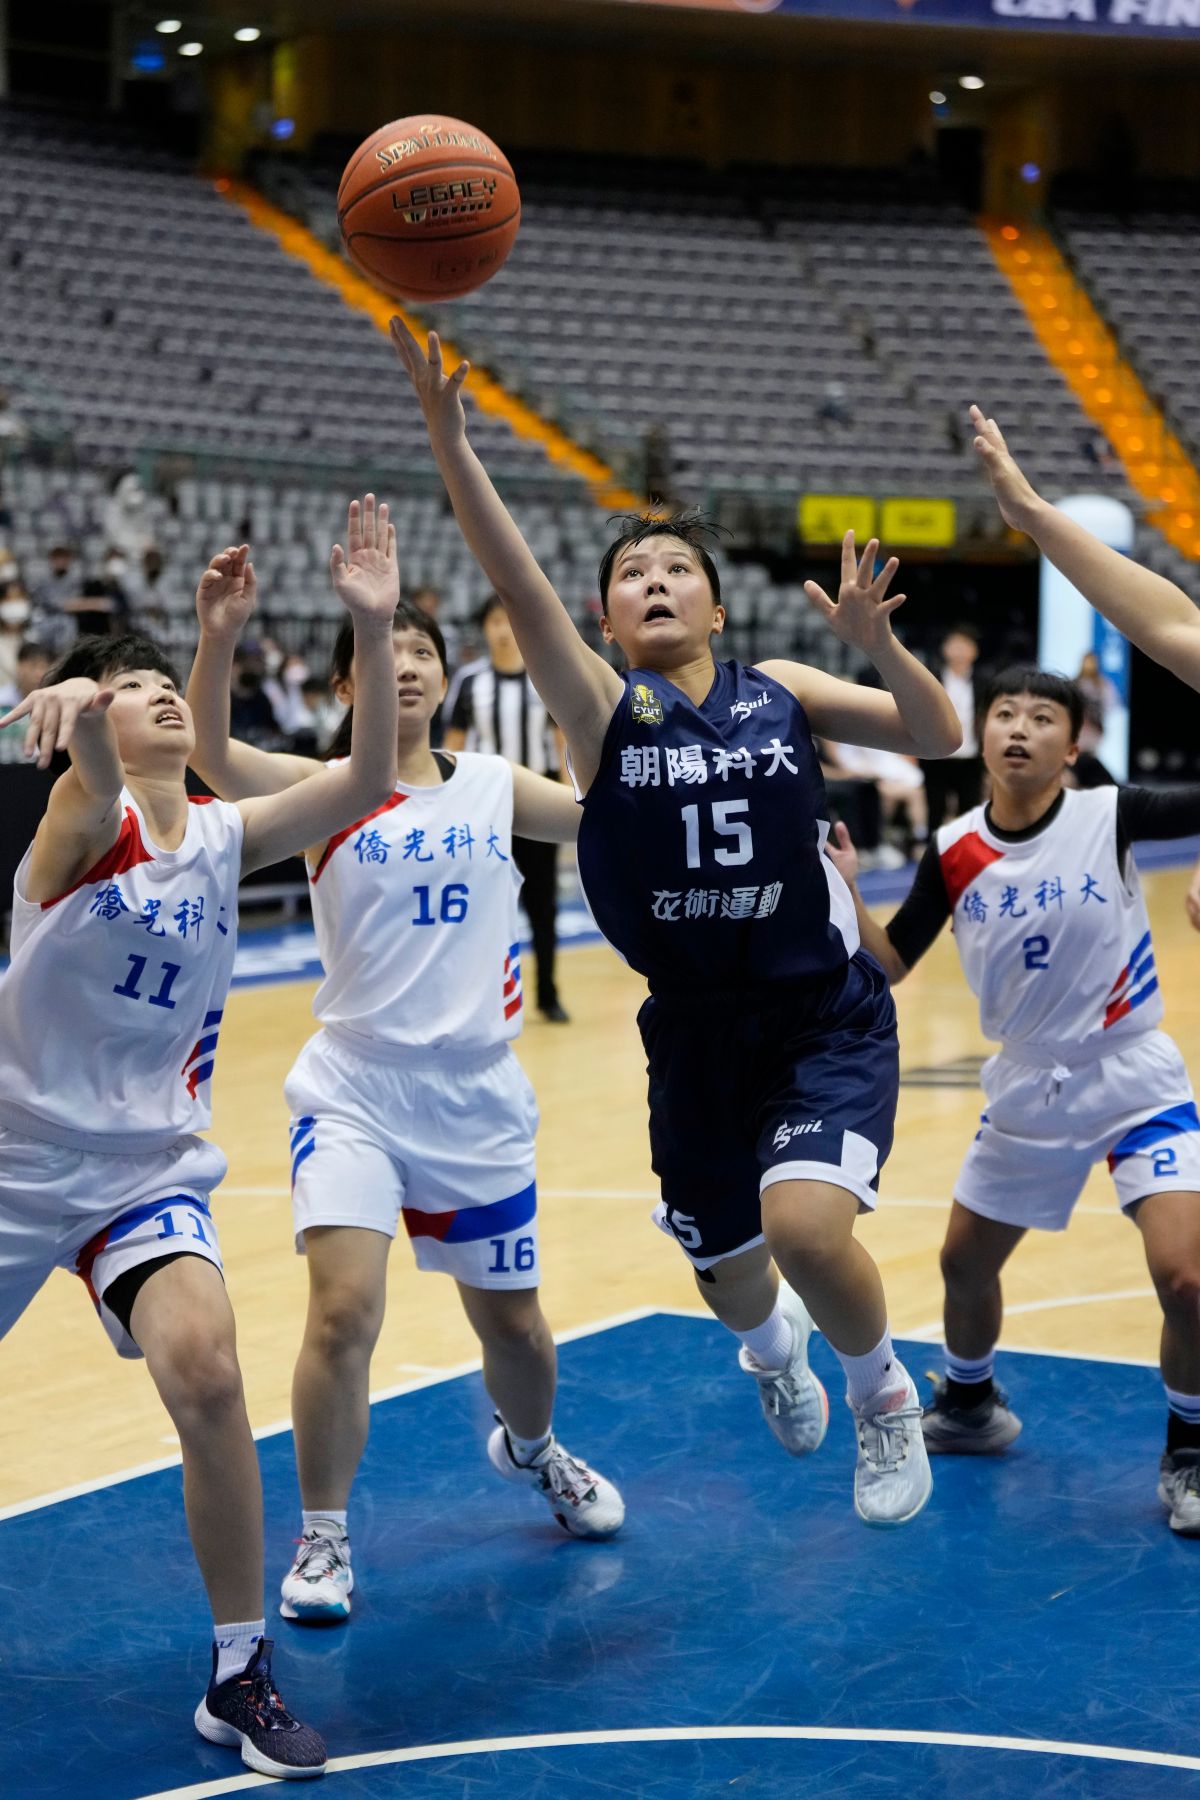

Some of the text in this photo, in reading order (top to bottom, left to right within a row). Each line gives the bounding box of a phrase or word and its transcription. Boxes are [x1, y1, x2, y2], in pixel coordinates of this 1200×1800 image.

[375, 130, 493, 173] SPALDING
[391, 177, 497, 210] LEGACY
[633, 705, 661, 716] CYUT
[619, 738, 799, 788] 朝陽科大
[353, 823, 509, 864] 僑光科大
[680, 798, 754, 869] 15
[412, 883, 469, 926] 16
[651, 880, 784, 921] 衣術運動
[962, 873, 1108, 924] 僑光科大
[1022, 934, 1050, 971] 2
[113, 953, 182, 1010] 11
[1151, 1148, 1179, 1178] 2
[154, 1211, 212, 1249] 11
[488, 1236, 535, 1273] 16
